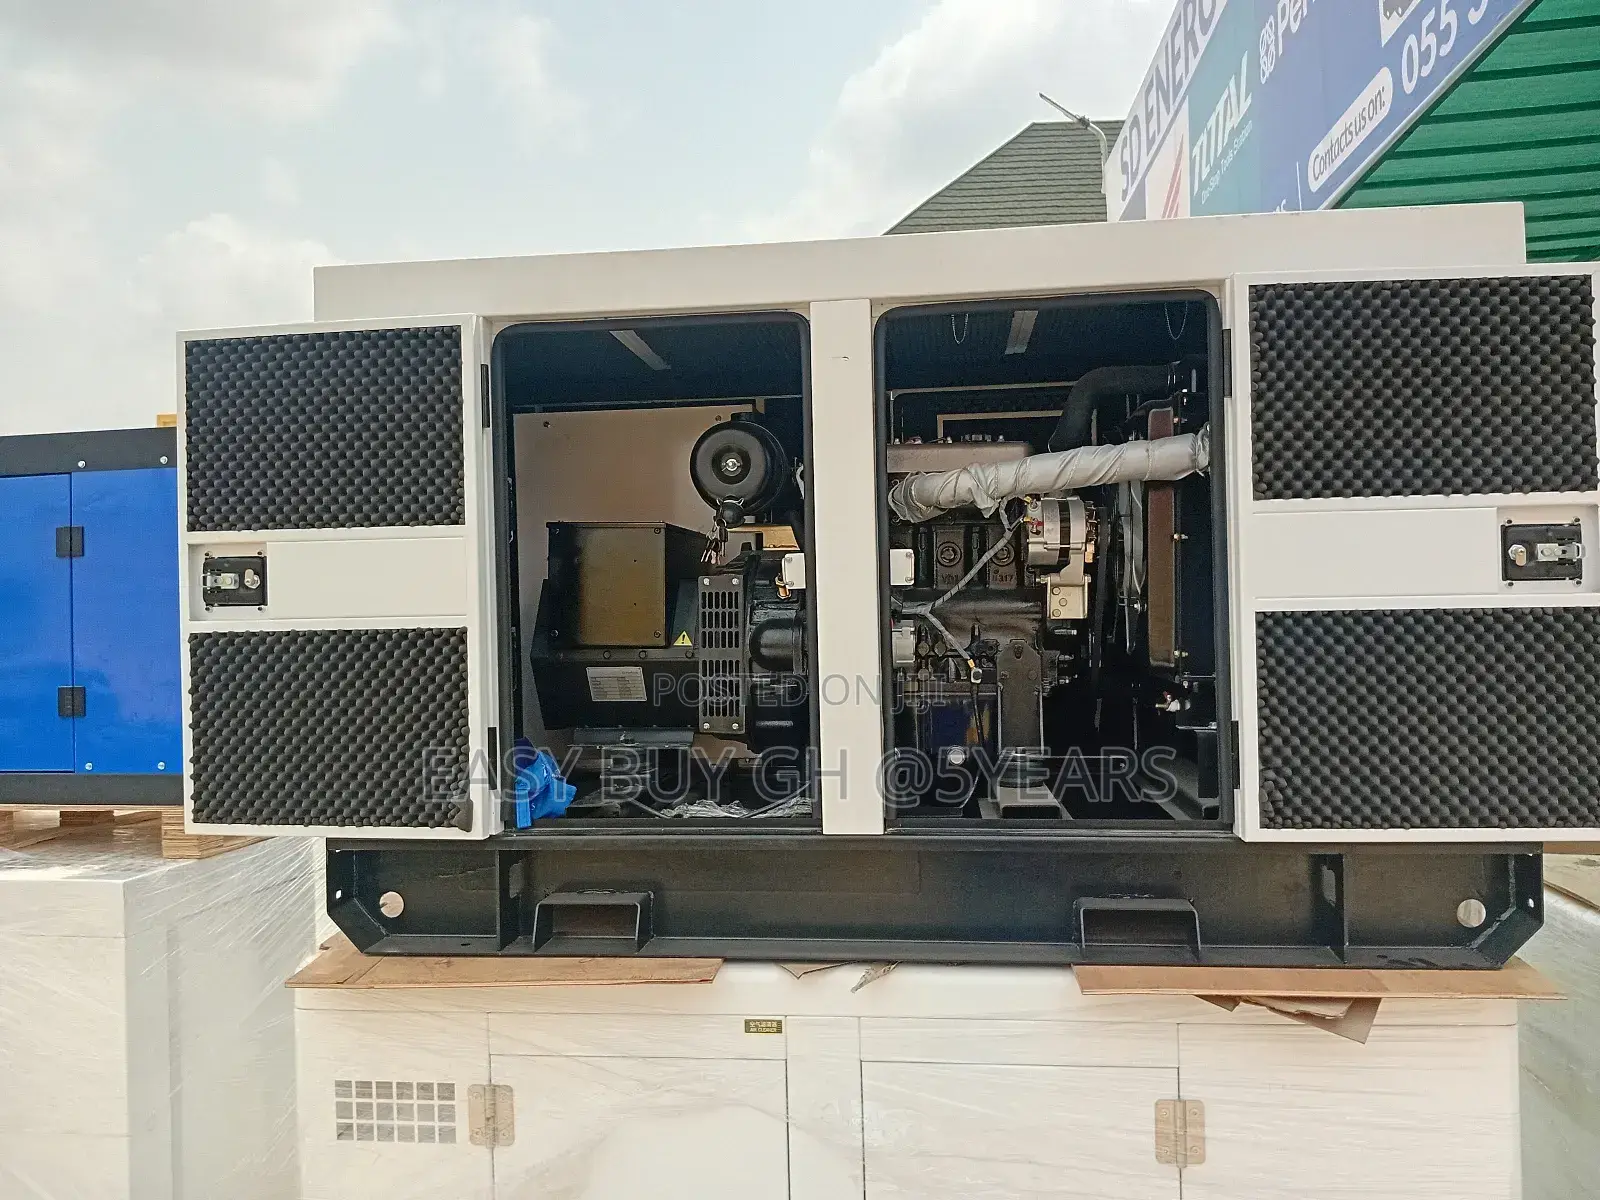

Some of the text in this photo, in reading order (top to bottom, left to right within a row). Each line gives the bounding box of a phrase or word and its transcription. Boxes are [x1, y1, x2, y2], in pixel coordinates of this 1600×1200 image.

[1120, 114, 1142, 202] SD
[1312, 86, 1386, 182] Contacts us on:
